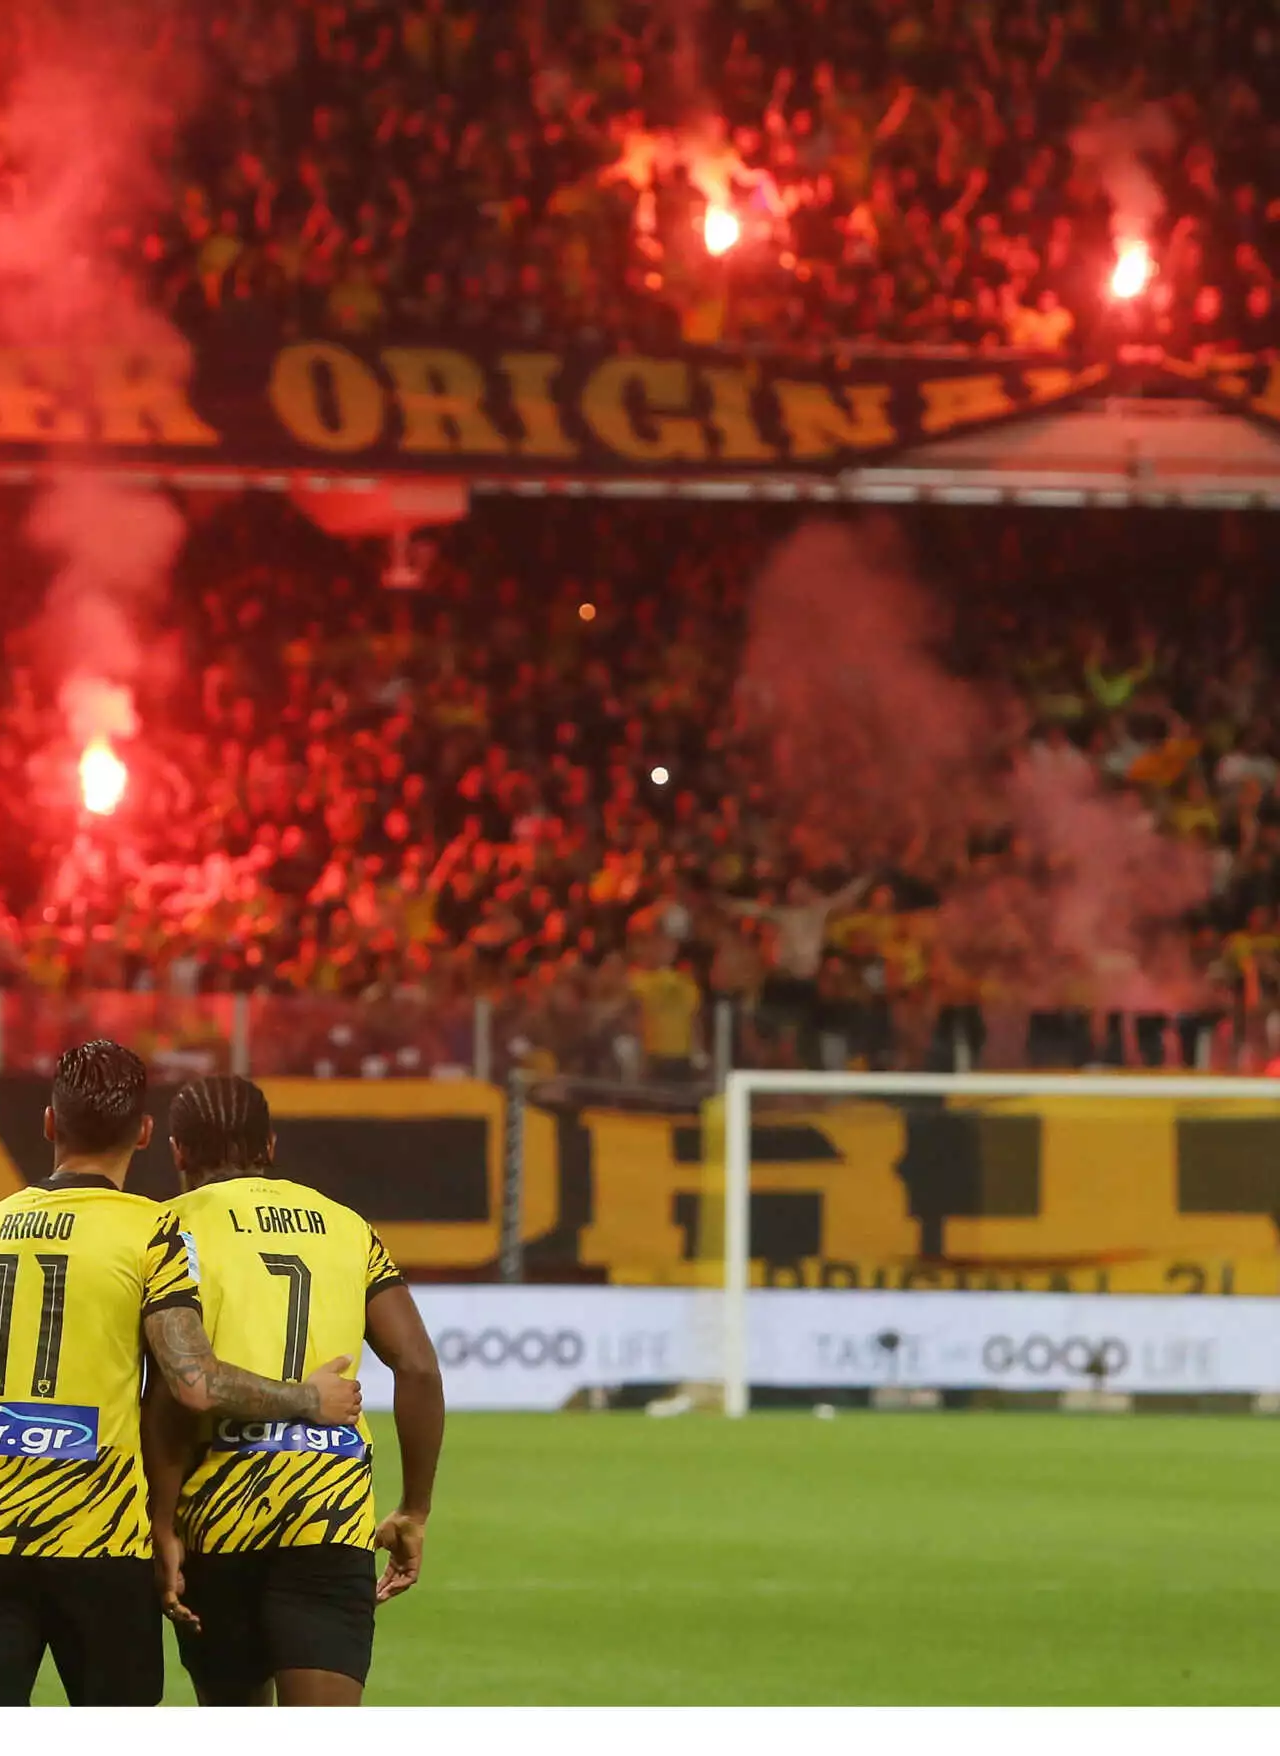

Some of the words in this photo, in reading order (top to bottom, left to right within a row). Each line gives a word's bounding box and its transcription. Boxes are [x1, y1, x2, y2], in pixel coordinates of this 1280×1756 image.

[229, 1209, 252, 1234] L.
[256, 1206, 327, 1235] GARCIA
[258, 1252, 312, 1383] 7
[437, 1326, 585, 1371] GOOD
[982, 1334, 1128, 1376] GOOD
